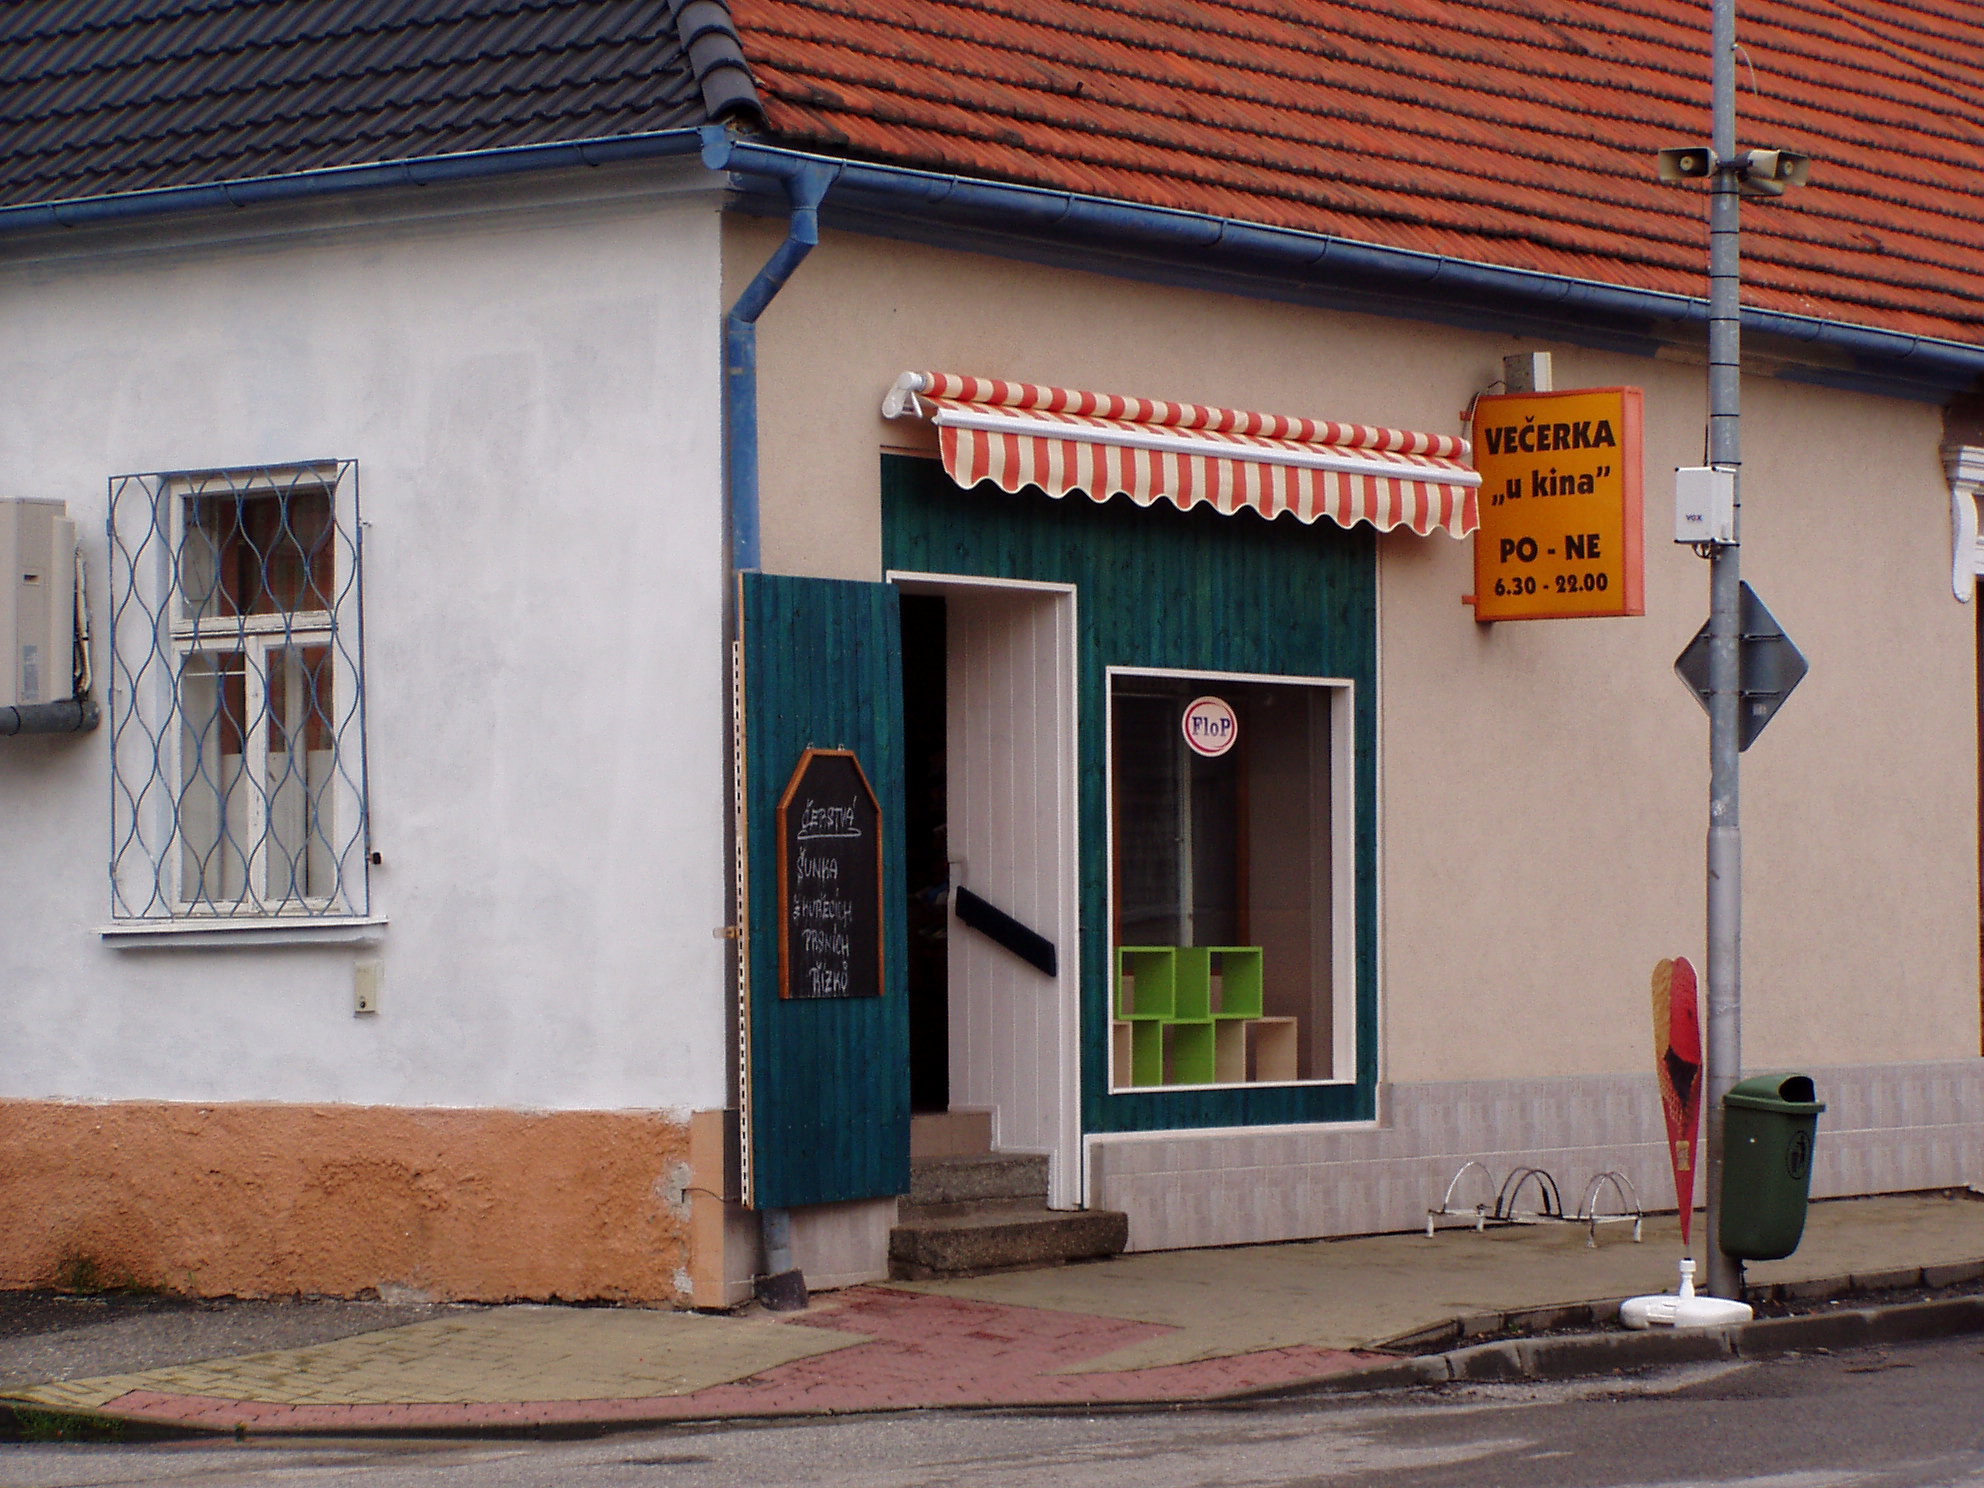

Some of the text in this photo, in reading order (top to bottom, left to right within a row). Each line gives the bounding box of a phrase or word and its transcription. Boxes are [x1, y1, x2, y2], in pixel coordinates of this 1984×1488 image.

[1484, 415, 1616, 455] VEČERKA
[1499, 536, 1538, 564] PO
[1565, 533, 1601, 561] NE
[1494, 576, 1537, 596] 6.30
[1555, 572, 1609, 593] 22.00
[1192, 716, 1231, 737] FloP
[797, 846, 838, 881] ŠUNKA
